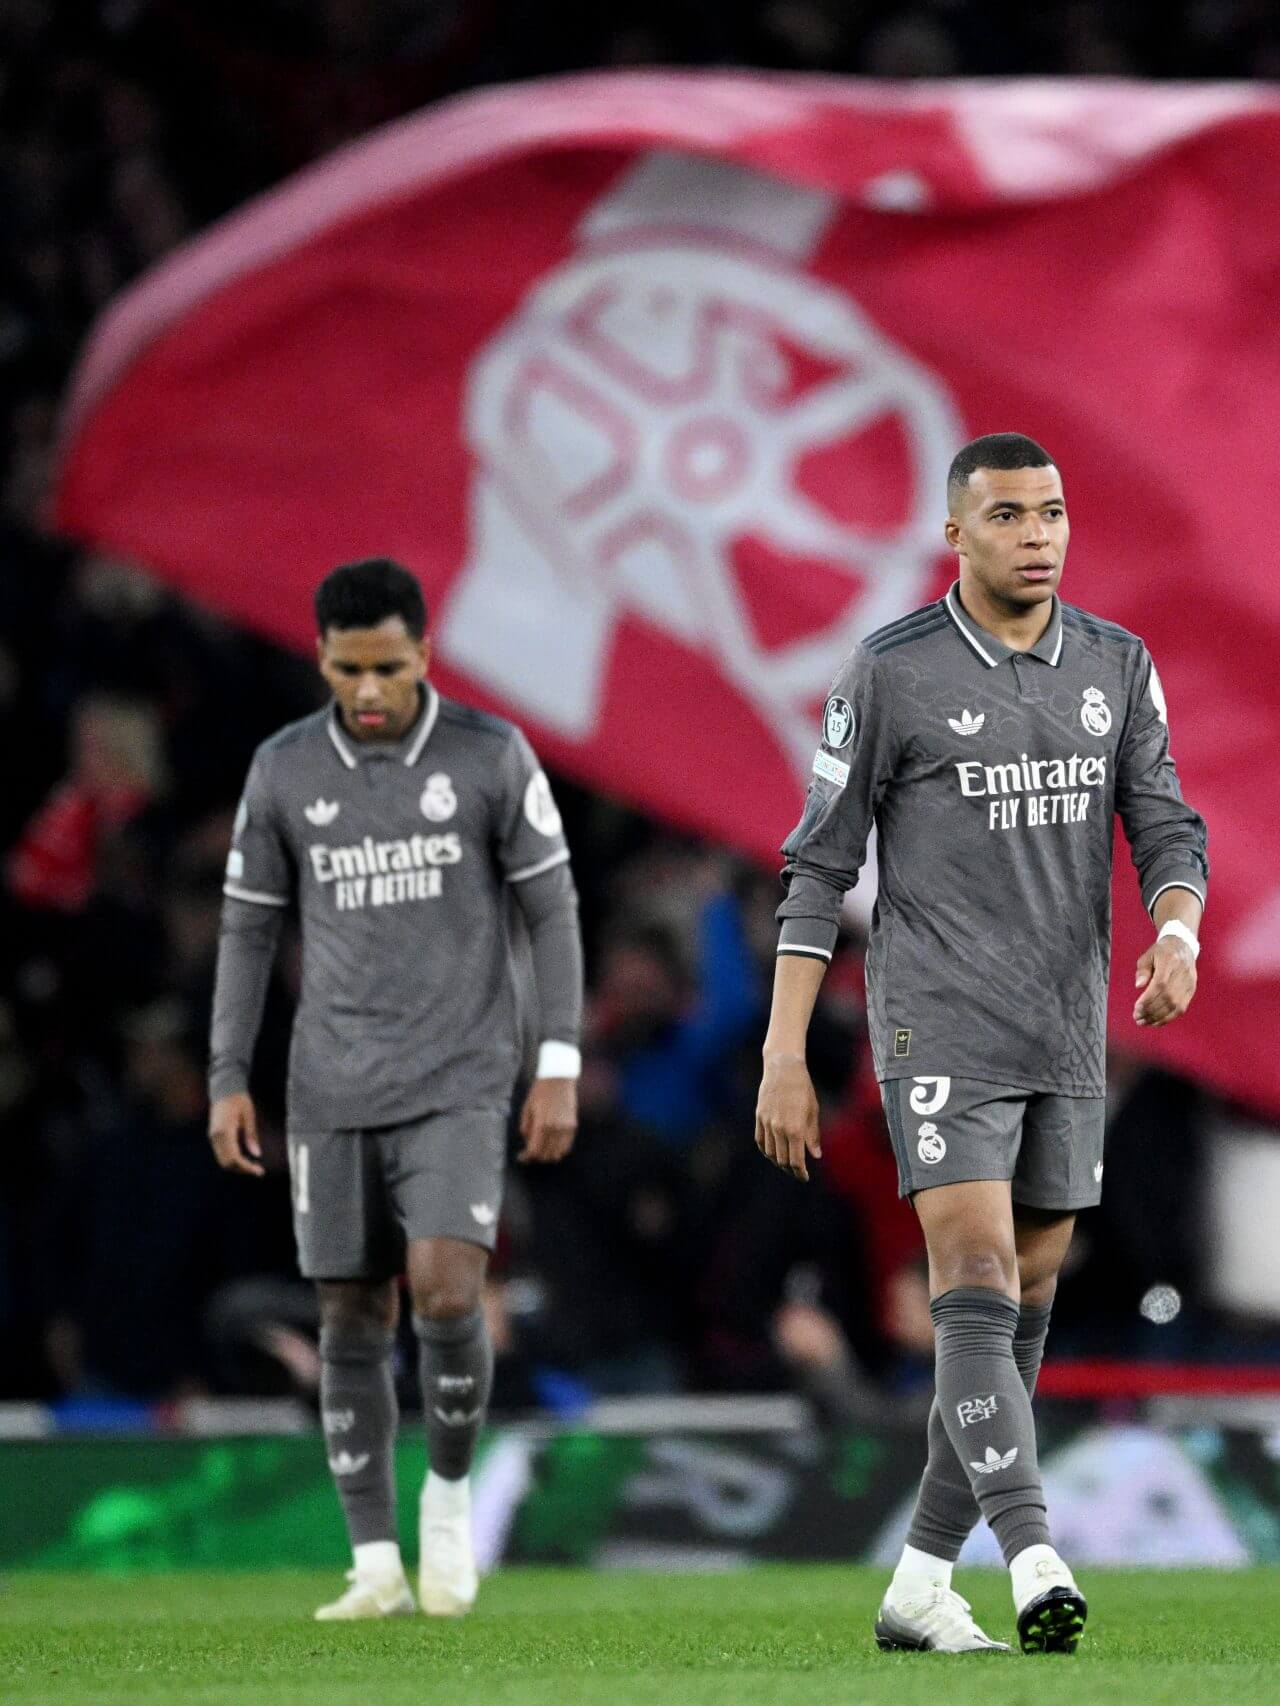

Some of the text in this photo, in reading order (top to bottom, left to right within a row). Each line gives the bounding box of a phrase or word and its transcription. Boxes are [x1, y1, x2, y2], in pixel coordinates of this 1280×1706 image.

[831, 719, 842, 733] 15
[954, 752, 1107, 797] Emirates
[989, 792, 1090, 830] FLY BETTER
[309, 831, 463, 882] Emirates
[335, 867, 442, 911] FLY BETTER
